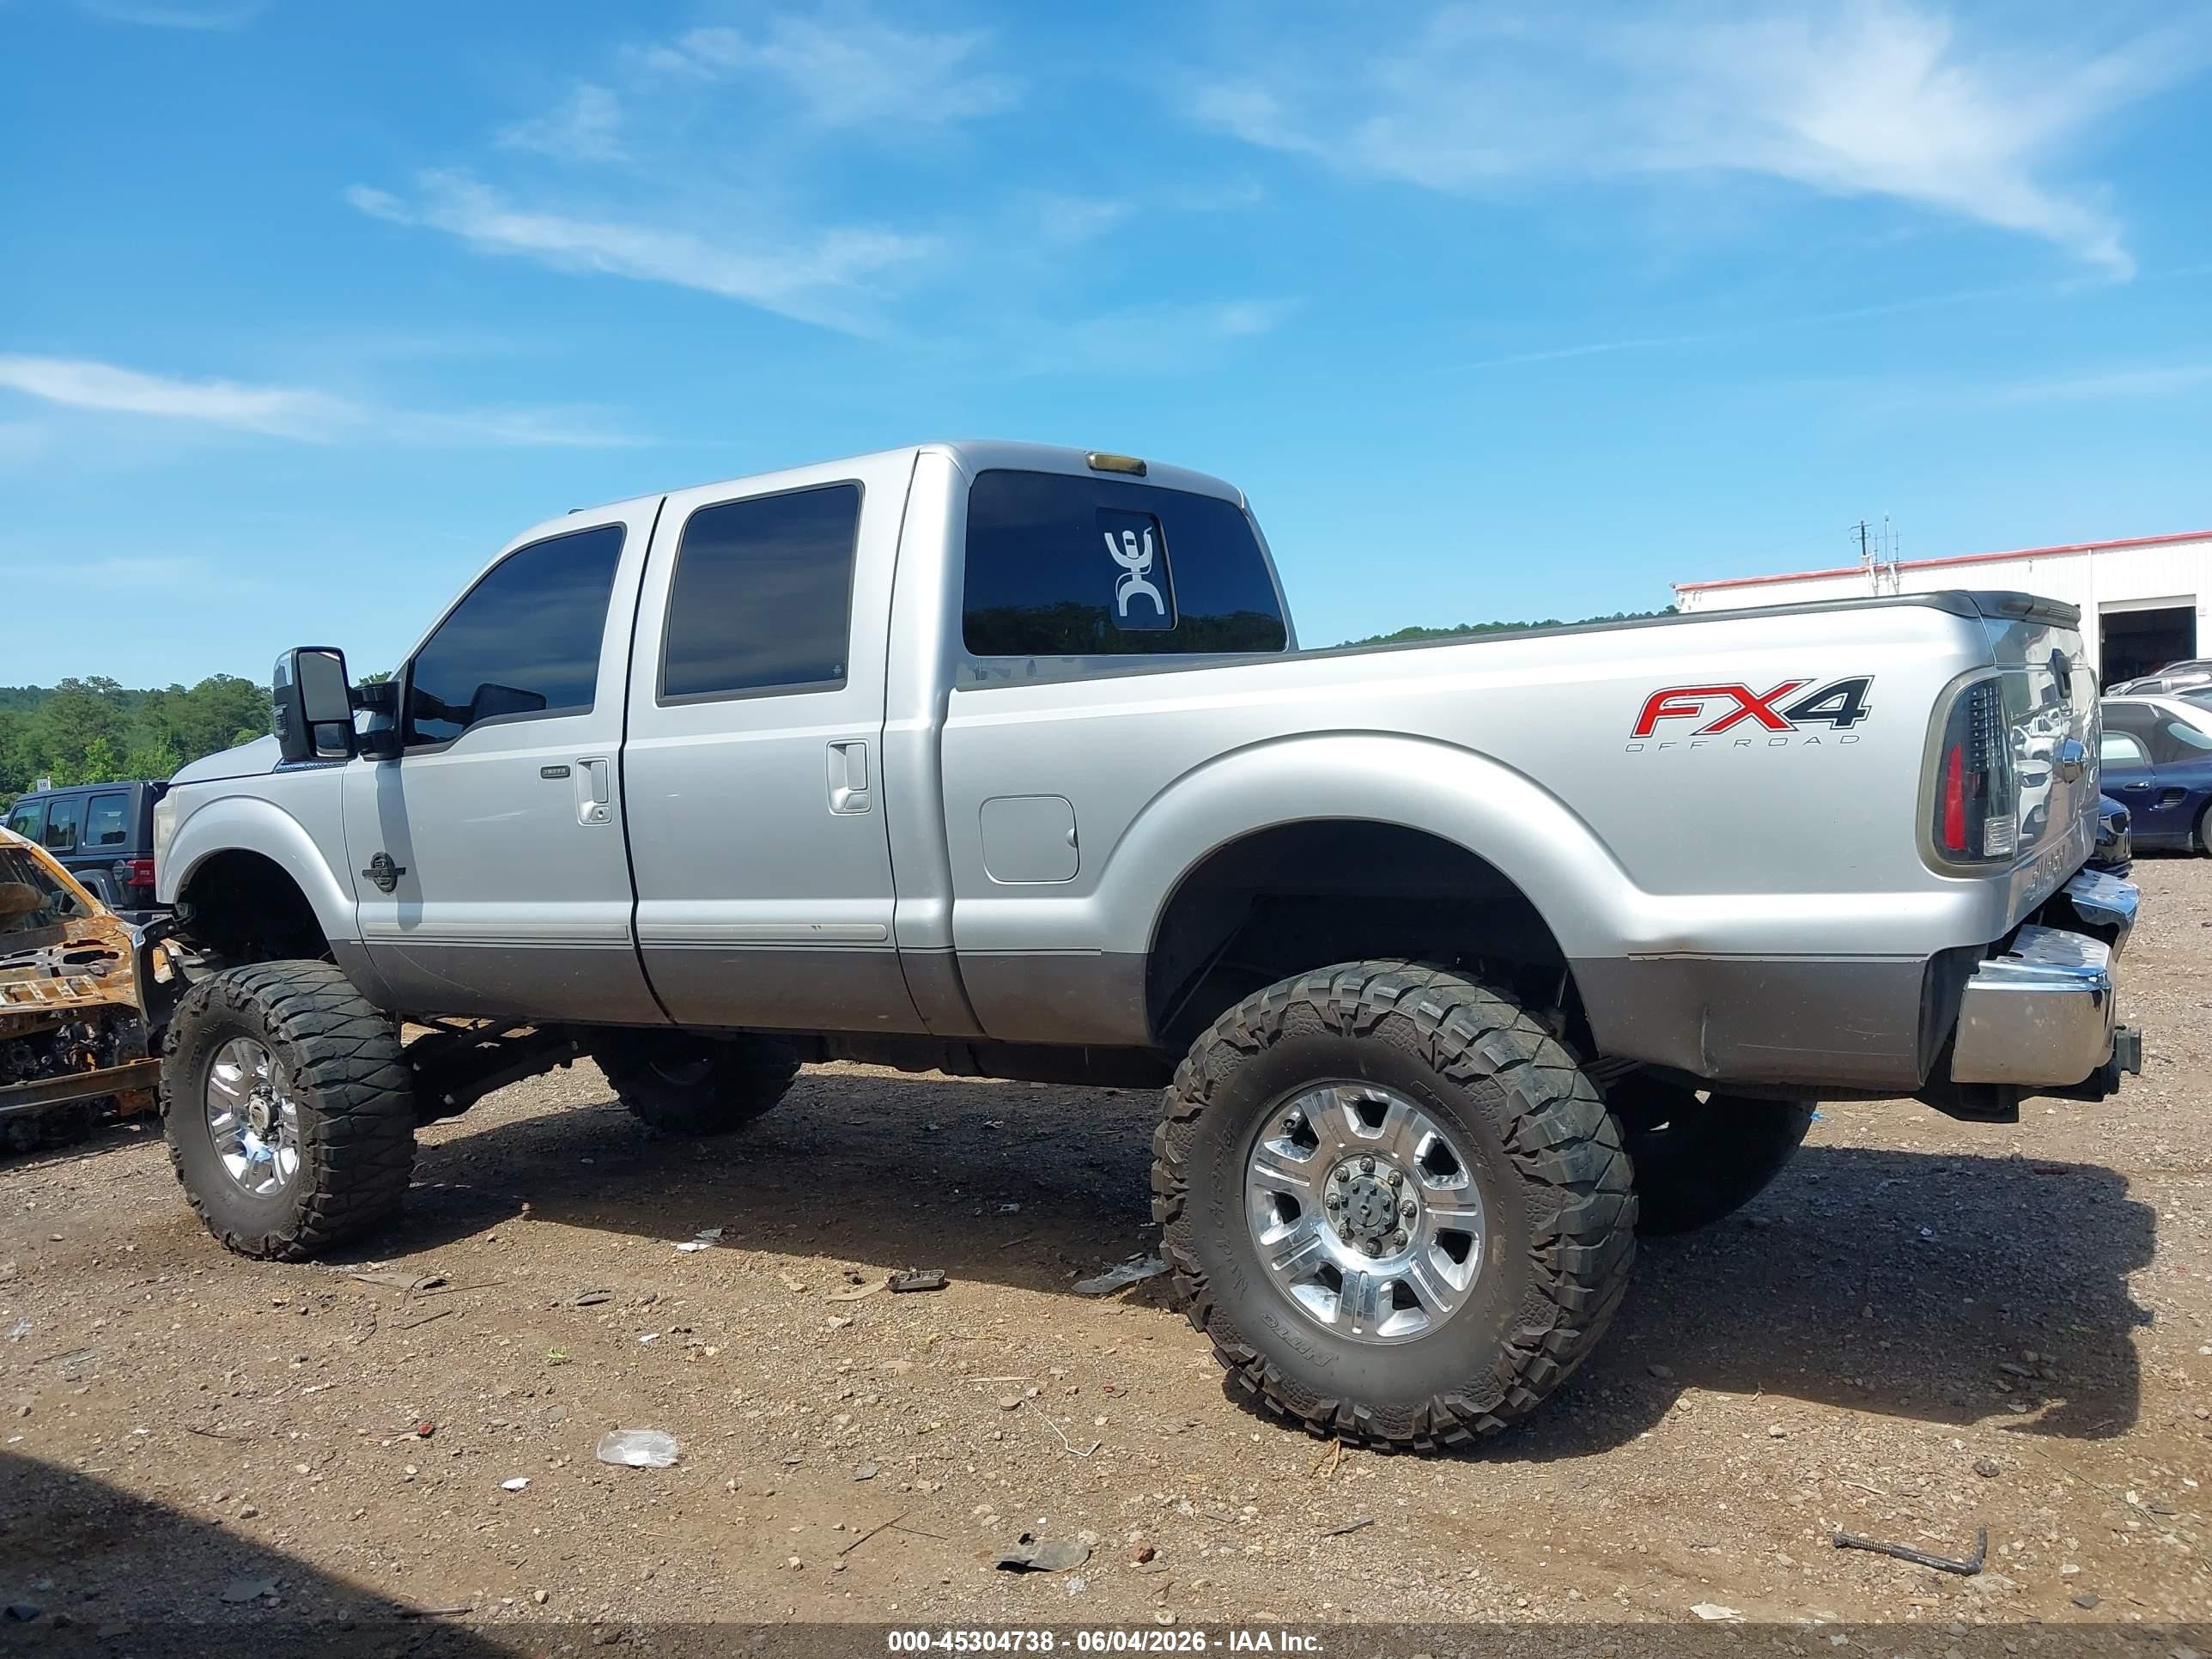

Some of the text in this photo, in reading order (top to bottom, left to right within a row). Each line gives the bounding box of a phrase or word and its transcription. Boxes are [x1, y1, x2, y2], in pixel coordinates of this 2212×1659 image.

[1630, 675, 1875, 738] FX4
[1625, 735, 1860, 753] OFF ROAD
